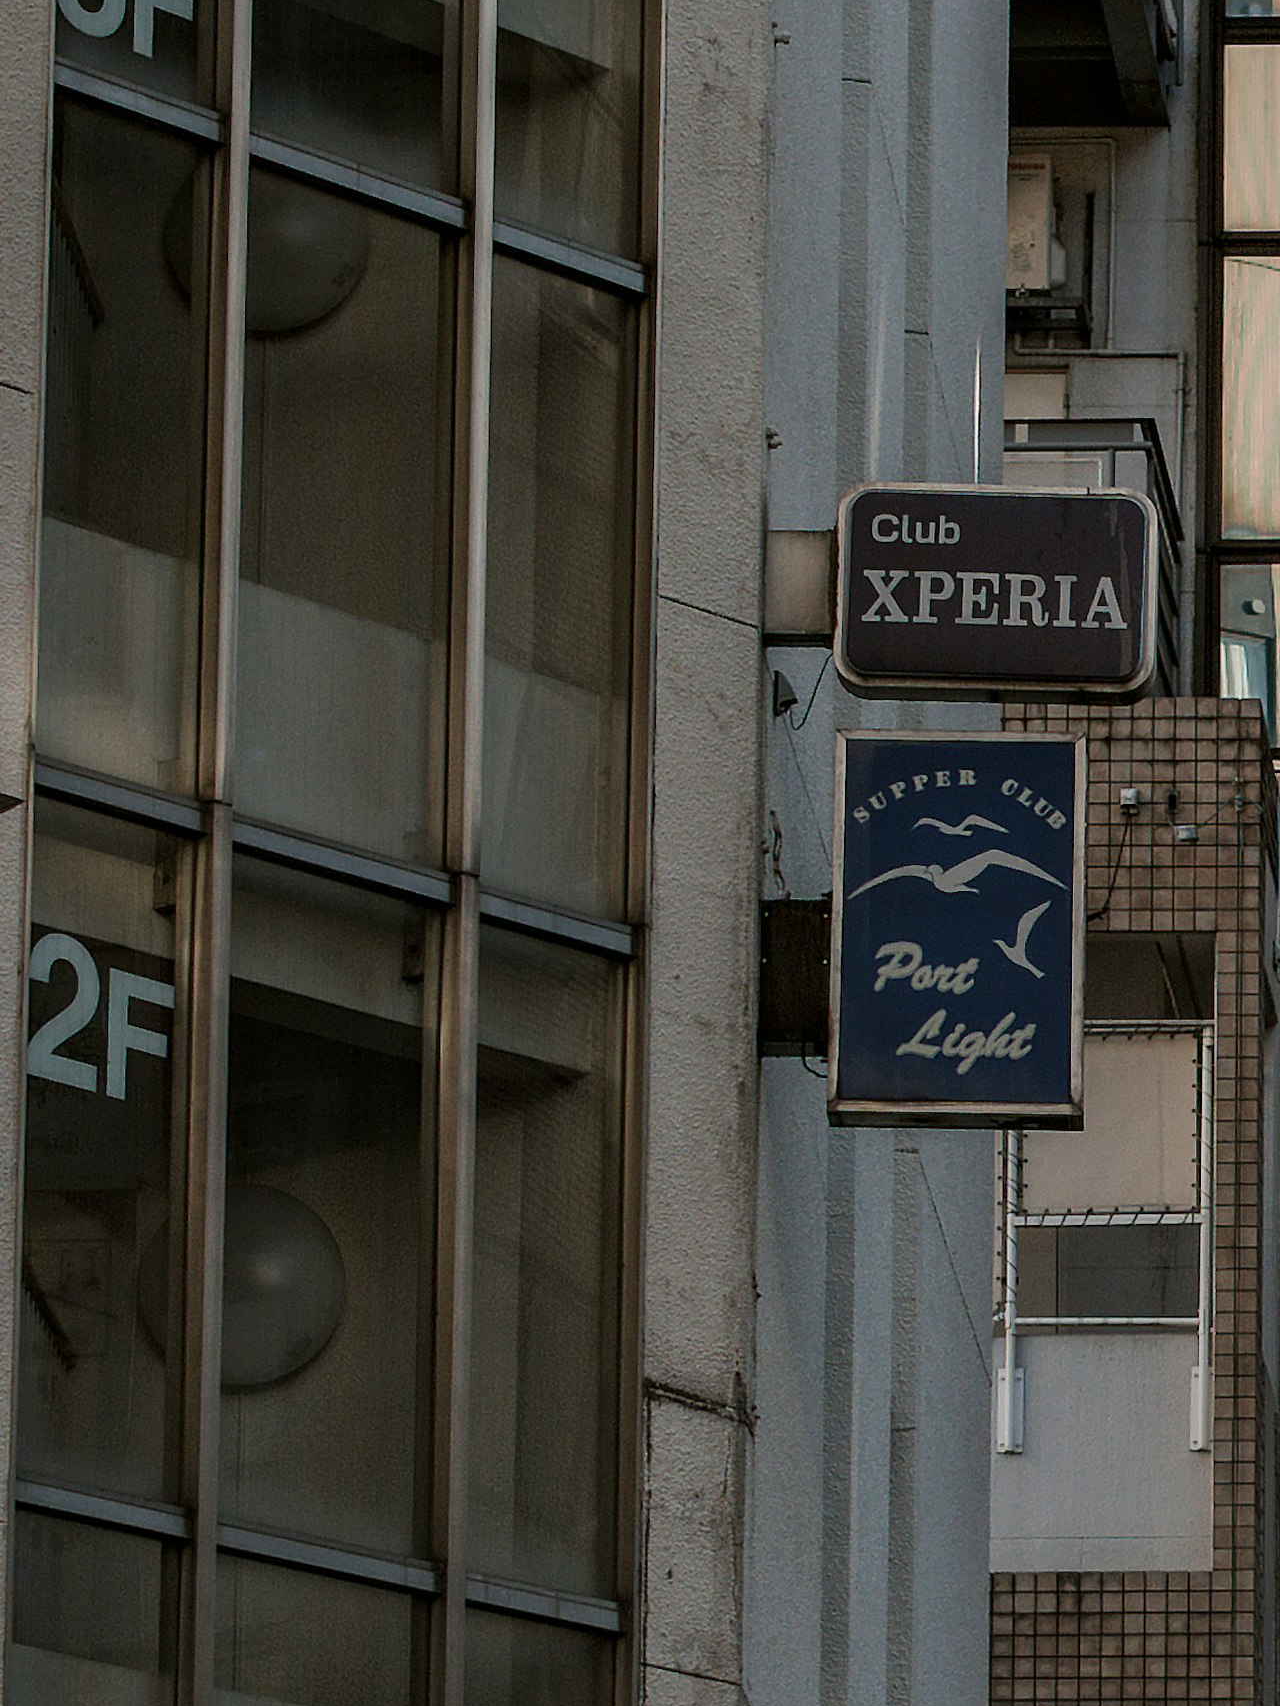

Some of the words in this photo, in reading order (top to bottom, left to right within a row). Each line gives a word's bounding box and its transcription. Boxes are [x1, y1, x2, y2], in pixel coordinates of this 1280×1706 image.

[871, 513, 961, 545] Club
[861, 568, 1128, 629] XPERIA
[853, 769, 977, 825] SUPPER
[1000, 778, 1067, 831] CLUB
[875, 941, 980, 993] Port
[27, 933, 175, 1101] 2F
[896, 1009, 1037, 1075] Light
